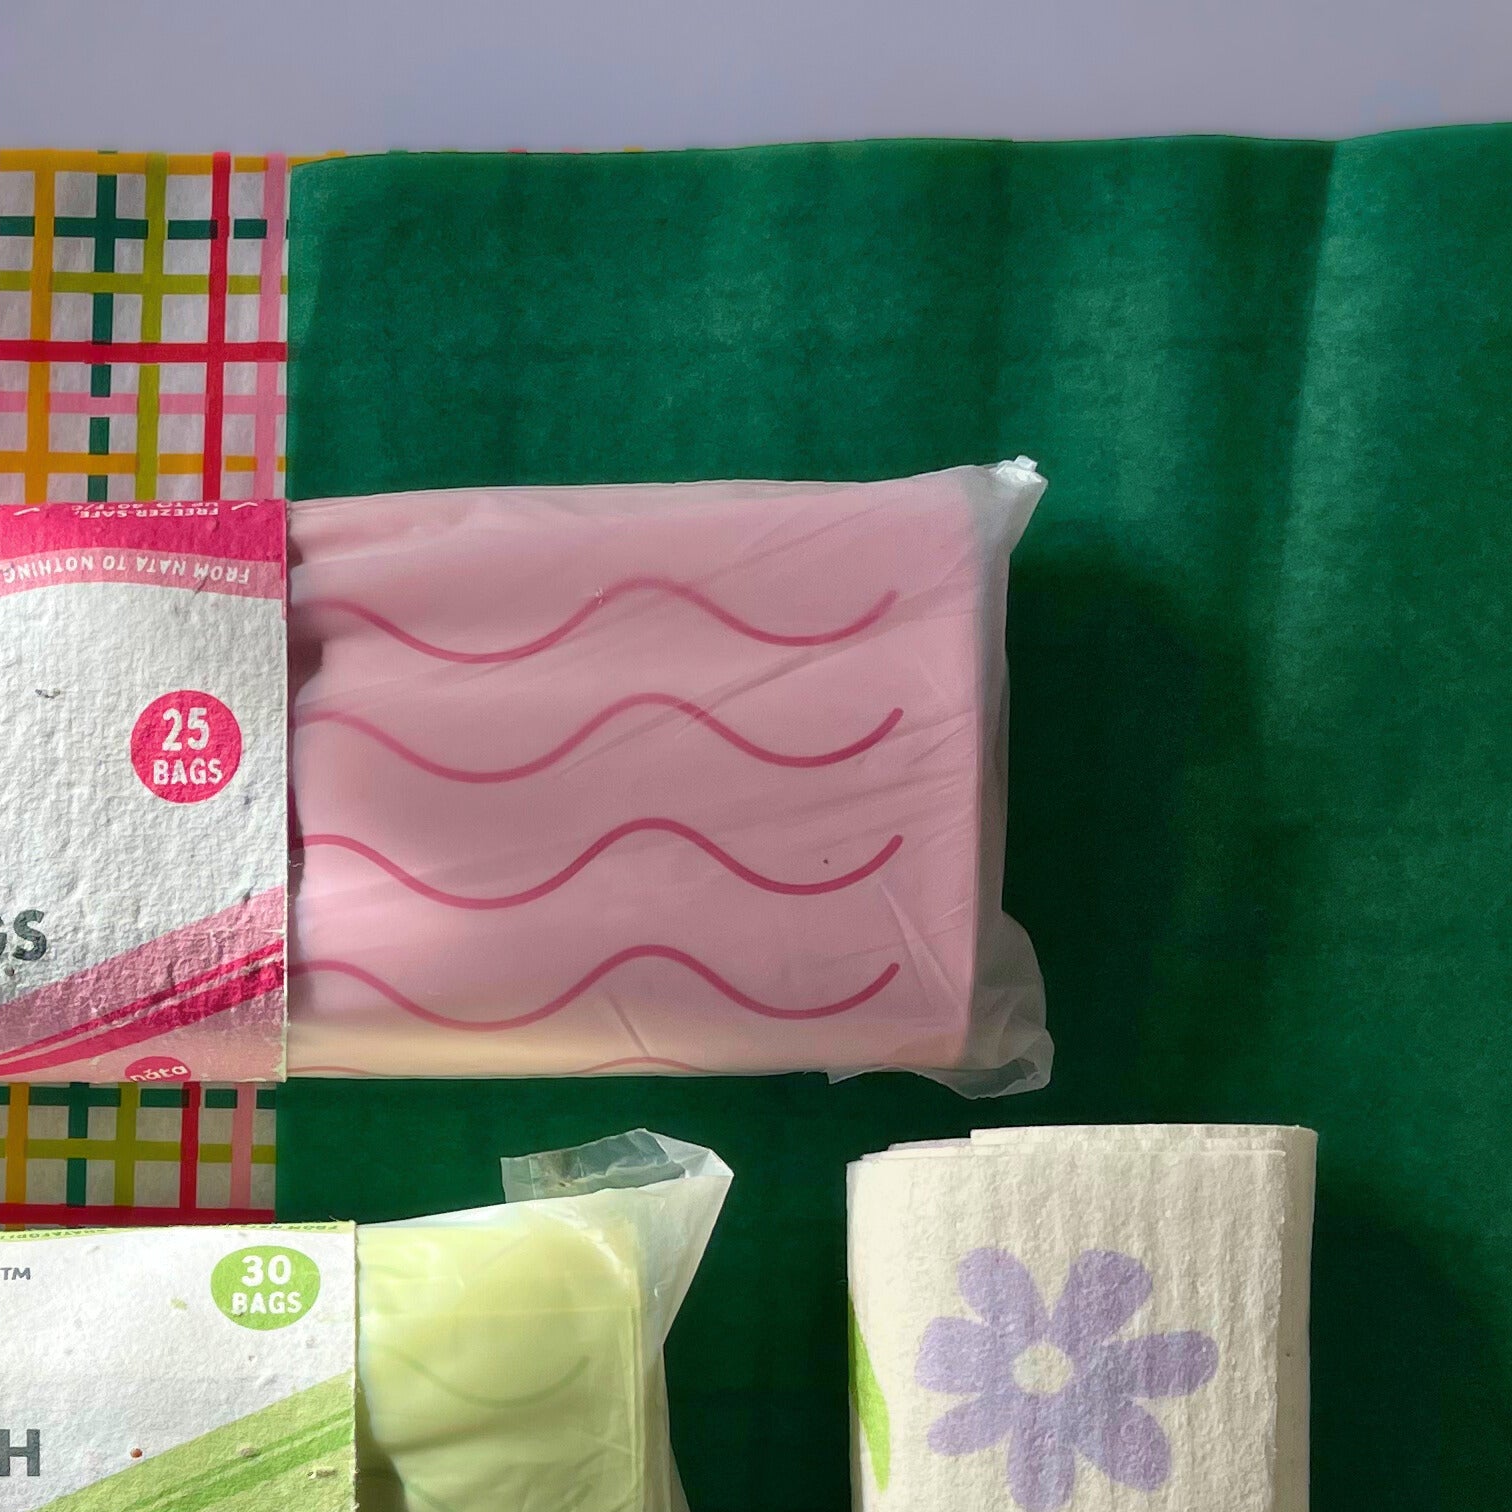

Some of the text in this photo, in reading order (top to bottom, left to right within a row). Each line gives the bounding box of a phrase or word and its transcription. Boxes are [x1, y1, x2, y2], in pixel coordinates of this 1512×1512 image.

[0, 554, 95, 582] NOTHING
[102, 554, 127, 572] TO
[135, 559, 187, 577] NATA
[191, 562, 252, 586] FROM
[161, 707, 211, 752] 25
[152, 757, 224, 787] BAGS
[240, 1254, 292, 1287] 30
[230, 1291, 303, 1316] BAGS
